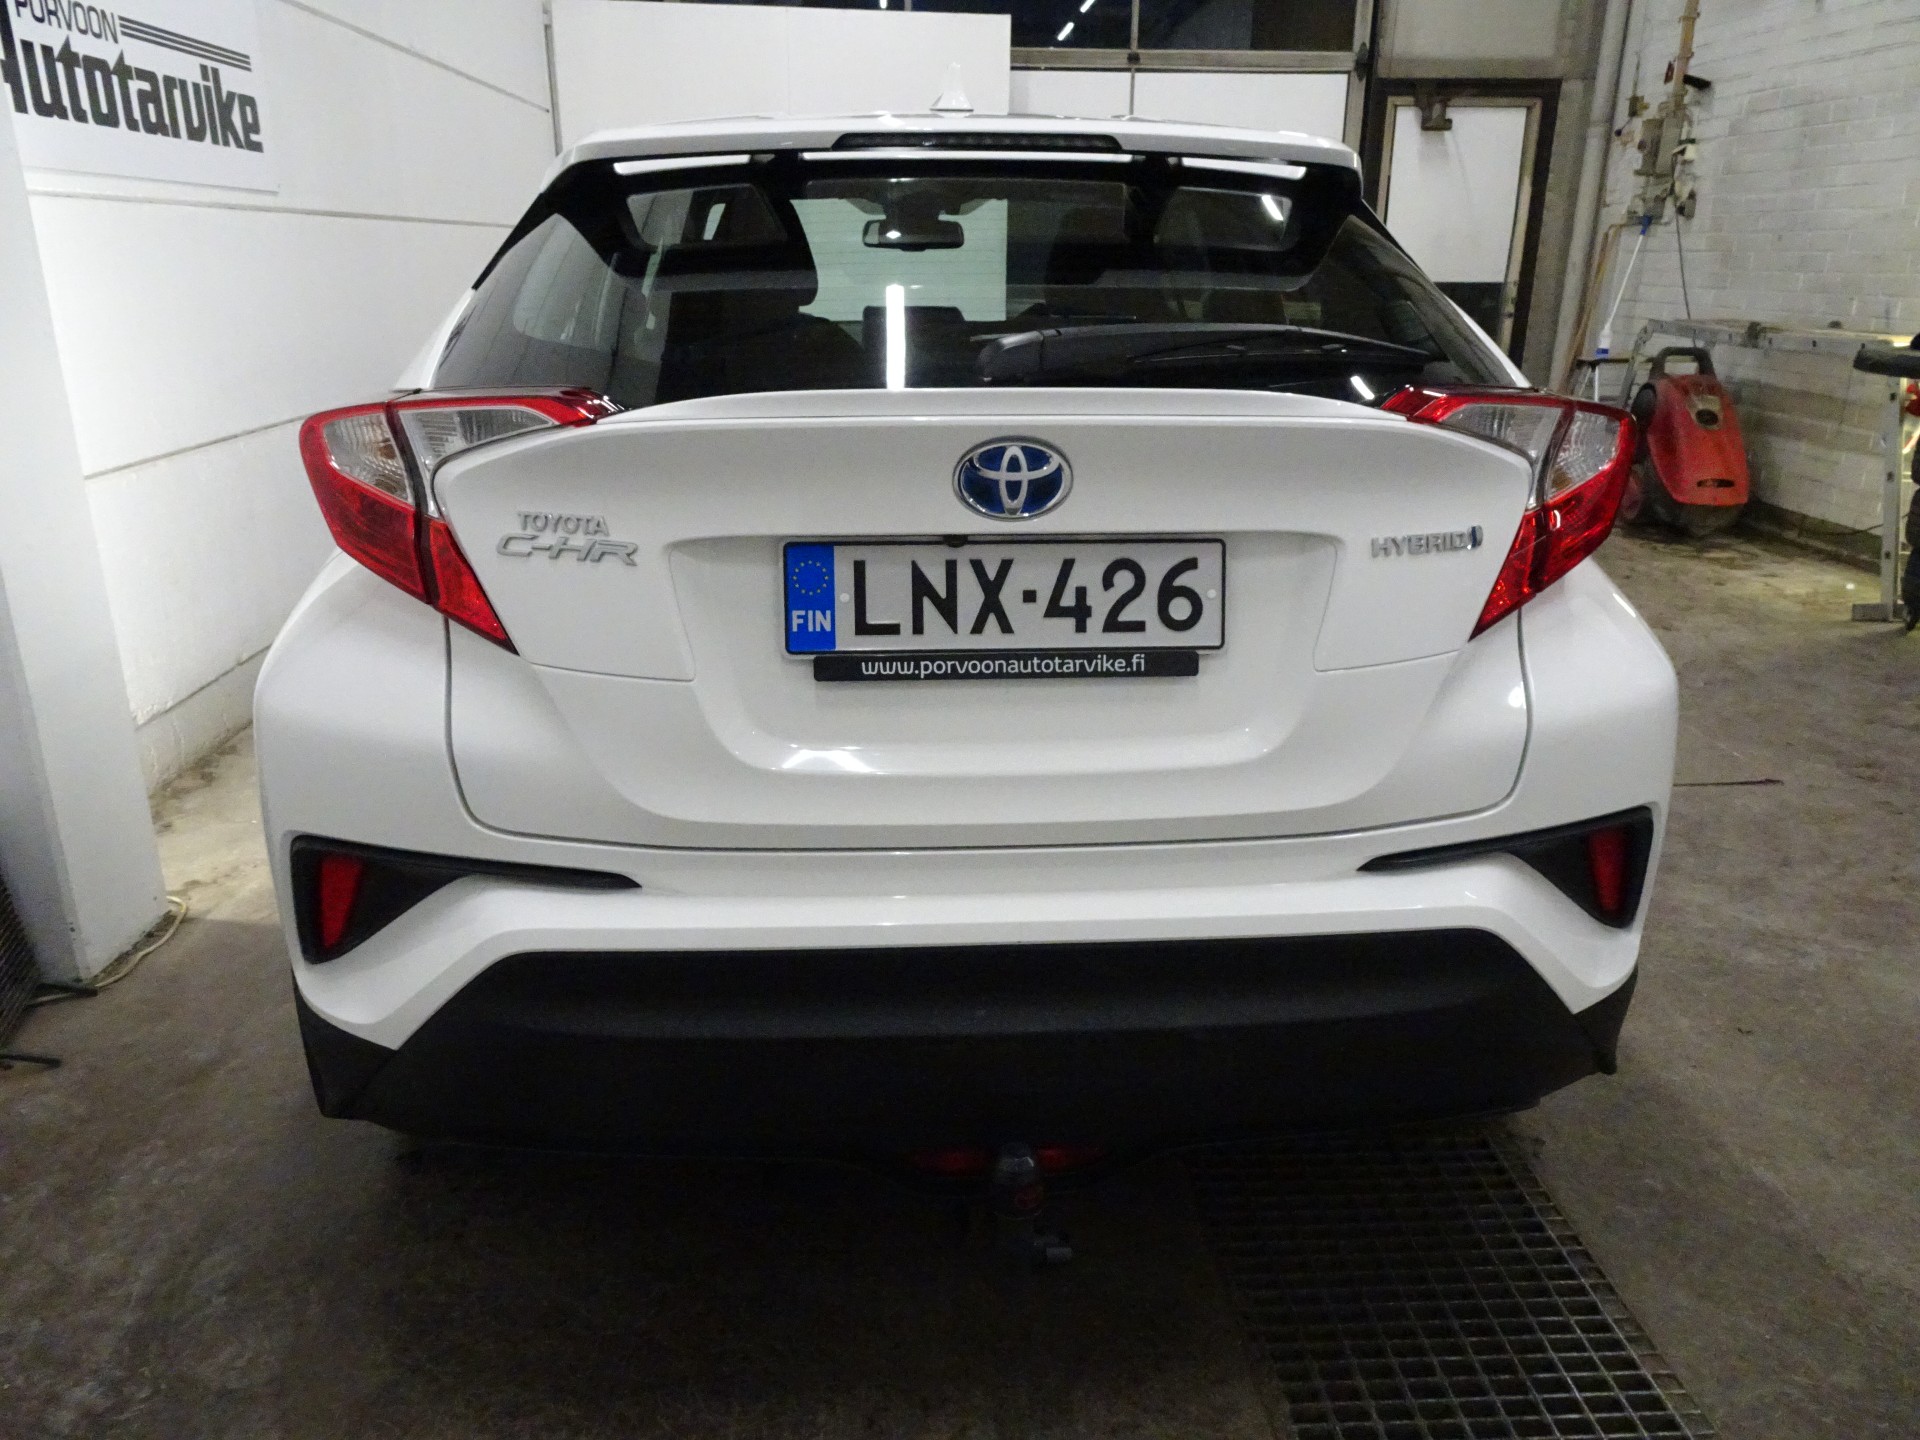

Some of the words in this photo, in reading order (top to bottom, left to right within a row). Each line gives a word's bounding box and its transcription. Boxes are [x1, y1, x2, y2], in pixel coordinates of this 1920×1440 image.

[517, 511, 610, 536] TOYOTA
[496, 532, 638, 567] C-HR
[1371, 530, 1468, 558] HYBRID
[852, 557, 1204, 635] LNX-426
[791, 610, 832, 632] FIN
[860, 654, 1146, 678] www.porvoonautotarvike.fi
